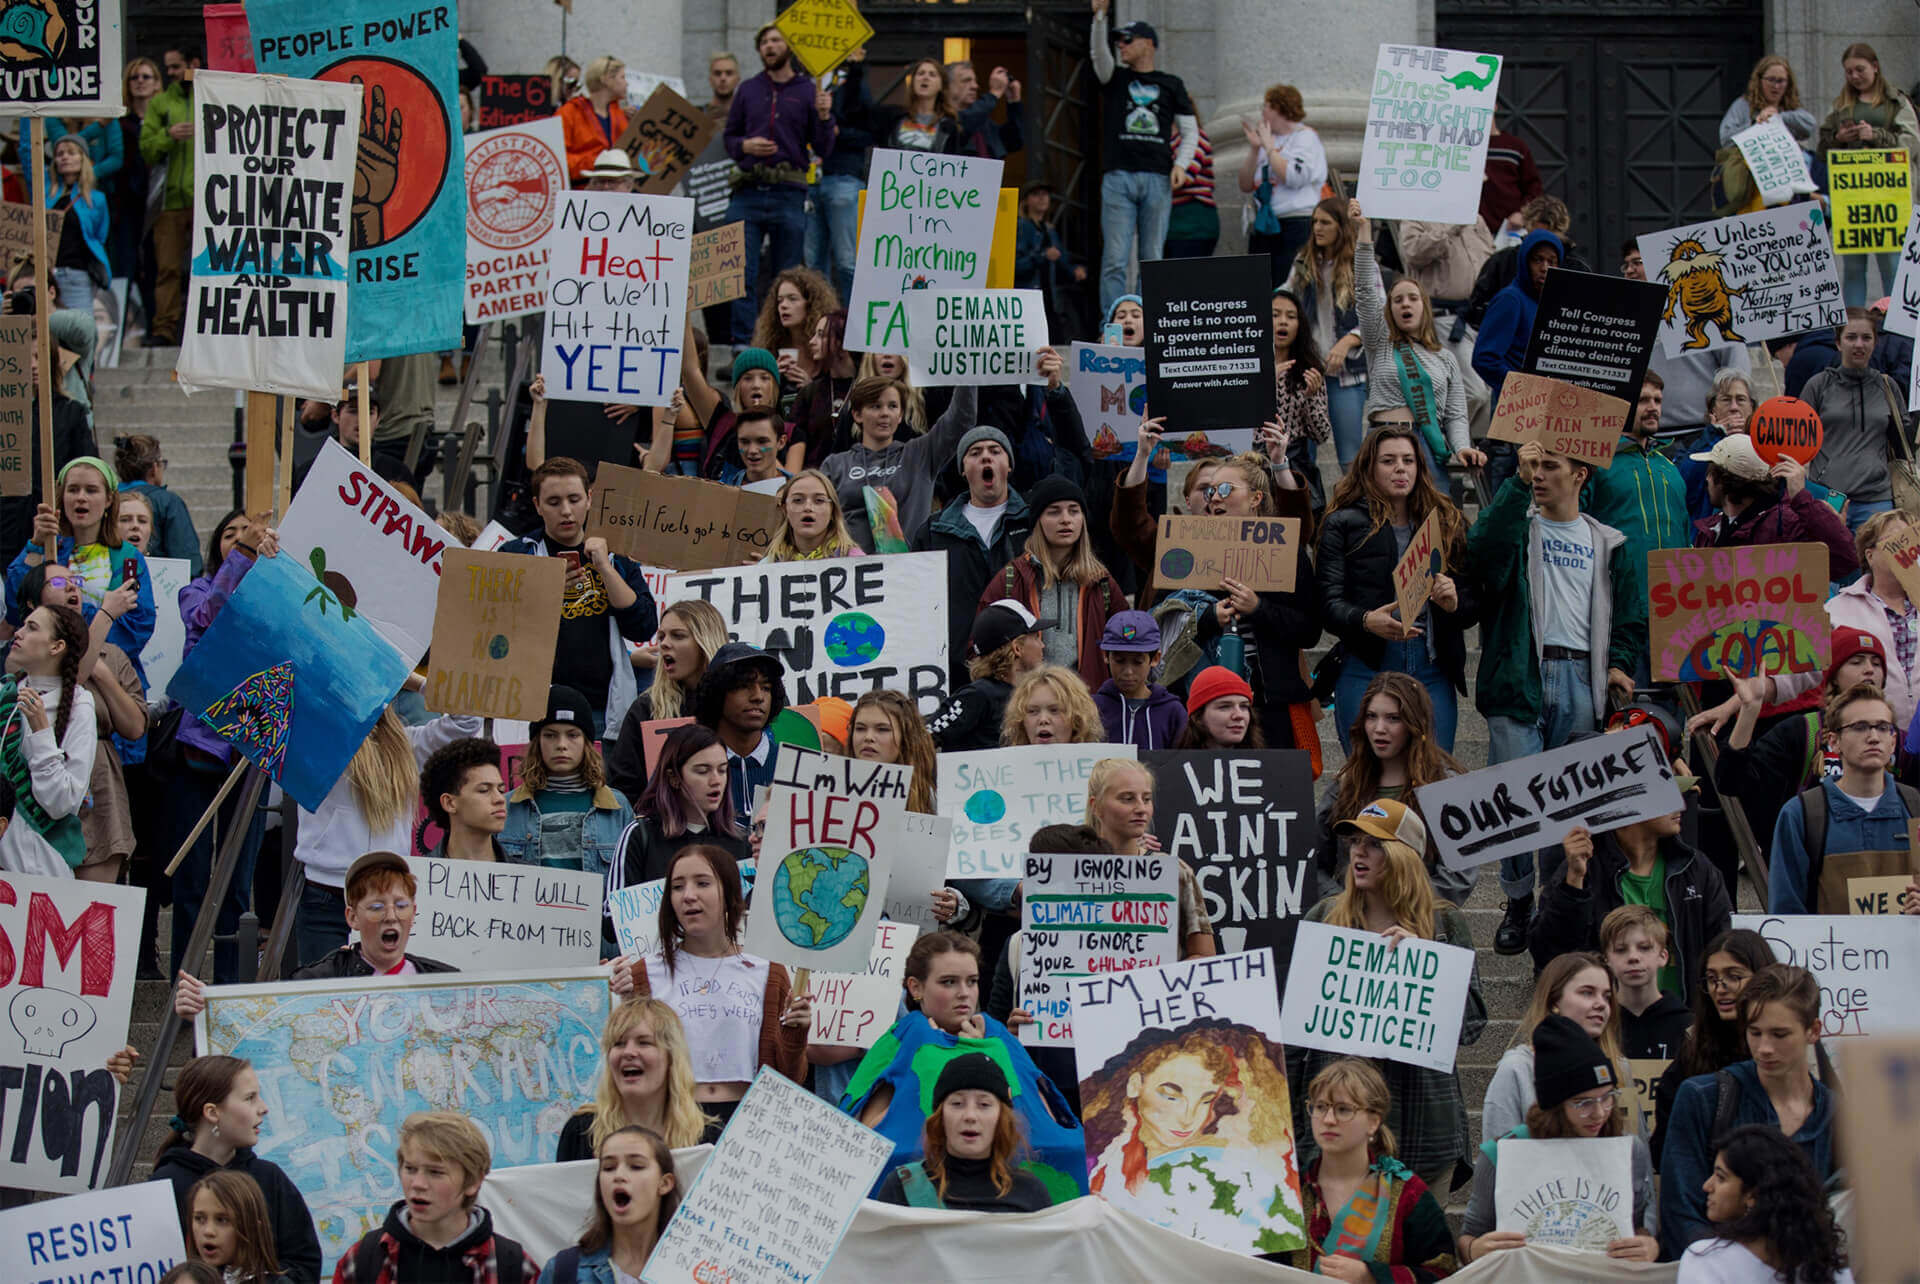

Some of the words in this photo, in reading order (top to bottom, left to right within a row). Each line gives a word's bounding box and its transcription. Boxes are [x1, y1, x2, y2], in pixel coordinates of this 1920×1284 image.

[260, 25, 354, 62] PEOPLE
[365, 7, 449, 46] POWER
[1388, 47, 1449, 72] THE
[481, 76, 521, 97] The
[1374, 69, 1450, 101] Dinos
[1372, 98, 1493, 131] THOUGHT
[203, 104, 345, 160] PROTECT
[1369, 121, 1434, 141] THEY
[1440, 126, 1483, 146] HAD
[243, 157, 295, 175] OUR
[899, 152, 903, 170] I
[910, 154, 968, 178] Can't
[1378, 142, 1472, 171] TIME
[1744, 138, 1776, 191] DEMAND
[1758, 134, 1790, 185] CLIMATE
[881, 170, 981, 211] Believe
[1374, 168, 1441, 188] TOO
[1834, 172, 1907, 189] PROFITS!
[205, 174, 344, 237] CLIMATE,
[561, 199, 610, 232] No
[618, 204, 685, 239] More
[1847, 203, 1898, 223] OVER
[696, 232, 718, 246] LIKE
[721, 226, 738, 241] MY
[909, 214, 952, 234] I'm
[1714, 221, 1776, 245] Unless
[205, 228, 332, 276] WATER
[580, 237, 673, 282] Heat
[716, 241, 739, 255] HOT
[874, 234, 977, 280] Marching
[1735, 234, 1803, 260] Someone
[356, 252, 419, 283] RISE
[720, 255, 741, 271] MY
[1731, 262, 1756, 278] like
[1756, 250, 1790, 273] YOU
[1794, 248, 1830, 265] cares
[233, 274, 291, 288] AND
[470, 271, 538, 299] PARTY
[553, 278, 597, 306] Or
[604, 282, 669, 308] We'll
[1761, 273, 1785, 285] whole
[936, 296, 1023, 320] DEMAND
[1166, 302, 1188, 313] Tell
[1190, 300, 1248, 312] Congress
[1742, 289, 1793, 309] Nothing
[1800, 286, 1811, 297] is
[1815, 281, 1840, 300] going
[197, 287, 335, 337] HEALTH
[1158, 318, 1190, 328] there
[1193, 316, 1203, 326] is
[1206, 317, 1222, 325] no
[1225, 315, 1257, 324] room
[1560, 308, 1581, 319] Tell
[1583, 311, 1636, 327] Congress
[1735, 310, 1745, 325] to
[1749, 304, 1779, 323] change
[1819, 304, 1846, 327] NOT
[552, 311, 594, 339] Hit
[606, 311, 670, 346] that
[935, 324, 1025, 348] CLIMATE
[1153, 333, 1165, 343] in
[1168, 330, 1242, 344] government
[1246, 327, 1263, 338] for
[1540, 331, 1551, 340] in
[1553, 334, 1623, 352] government
[1626, 342, 1643, 354] for
[1549, 319, 1578, 332] there
[1581, 322, 1591, 334] is
[1593, 325, 1608, 335] no
[1610, 328, 1640, 340] room
[928, 352, 1031, 375] JUSTICE!!
[1162, 345, 1206, 357] climate
[1210, 343, 1255, 355] deniers
[1544, 345, 1586, 359] climate
[1588, 352, 1631, 365] deniers
[555, 344, 679, 396] YEET
[1164, 366, 1181, 374] Text
[1182, 364, 1217, 373] CLIMATE
[1229, 362, 1255, 370] 71333
[1558, 363, 1592, 375] CLIMATE
[1172, 381, 1202, 389] Answer
[1204, 379, 1221, 387] with
[1223, 378, 1248, 386] Action
[1503, 381, 1522, 399] WE
[1497, 392, 1547, 417] CANNOT
[1514, 414, 1581, 433] SUSTAIN
[1591, 416, 1624, 428] THIS
[1756, 414, 1818, 447] CAUTION
[1556, 438, 1611, 458] SYSTEM
[600, 488, 649, 529] Fossil
[653, 506, 689, 534] Fuels
[1165, 520, 1171, 538] I
[1180, 519, 1239, 541] MARCH
[1240, 521, 1286, 544] FOR
[1223, 548, 1283, 584] FUTURE
[1665, 550, 1705, 586] I'D
[1712, 547, 1754, 582] BE
[1764, 546, 1798, 574] IN
[466, 565, 526, 602] THERE
[685, 562, 884, 624] THERE
[1650, 573, 1818, 618] SCHOOL
[1669, 613, 1708, 650] THE
[1706, 601, 1787, 630] EARTH
[1690, 627, 1815, 680] COOL
[433, 670, 503, 713] PLANET
[774, 742, 836, 791] I'm
[848, 759, 906, 799] With
[954, 764, 1016, 790] SAVE
[1034, 758, 1094, 784] THE
[1183, 758, 1264, 806] WE
[1440, 782, 1533, 841] OUR
[1527, 731, 1673, 813] FUTURE!
[790, 790, 880, 859] HER
[952, 822, 1022, 845] BEES
[1170, 802, 1298, 862] AIN'T
[429, 861, 525, 903] PLANET
[535, 877, 590, 907] WILL
[1026, 857, 1052, 884] BY
[1074, 858, 1162, 881] IGNORING
[1076, 882, 1125, 894] THIS
[1031, 901, 1105, 924] CLIMATE
[1111, 901, 1168, 925] CRISIS
[1855, 892, 1889, 914] WE
[432, 912, 479, 938] BACK
[488, 919, 545, 945] FROM
[550, 927, 594, 948] THIS
[1023, 932, 1059, 956] YOU
[1079, 932, 1148, 954] IGNORE
[1033, 956, 1075, 978] YOUR
[1328, 935, 1439, 980] DEMAND
[808, 978, 853, 1005] WHY
[1024, 982, 1050, 995] AND
[1078, 974, 1144, 1007] IM
[1159, 952, 1266, 993] WITH
[1321, 971, 1435, 1016] CLIMATE
[331, 984, 507, 1046] YOUR
[1139, 991, 1216, 1026] HER
[816, 1009, 875, 1042] WE?
[1304, 1004, 1436, 1053] JUSTICE!!
[819, 1159, 856, 1190] WANT
[709, 1179, 752, 1215] WANT
[1510, 1177, 1568, 1220] THERE
[1575, 1177, 1590, 1200] IS
[1595, 1183, 1620, 1212] NO
[26, 1214, 134, 1266] RESIST
[723, 1225, 752, 1251] FEEL
